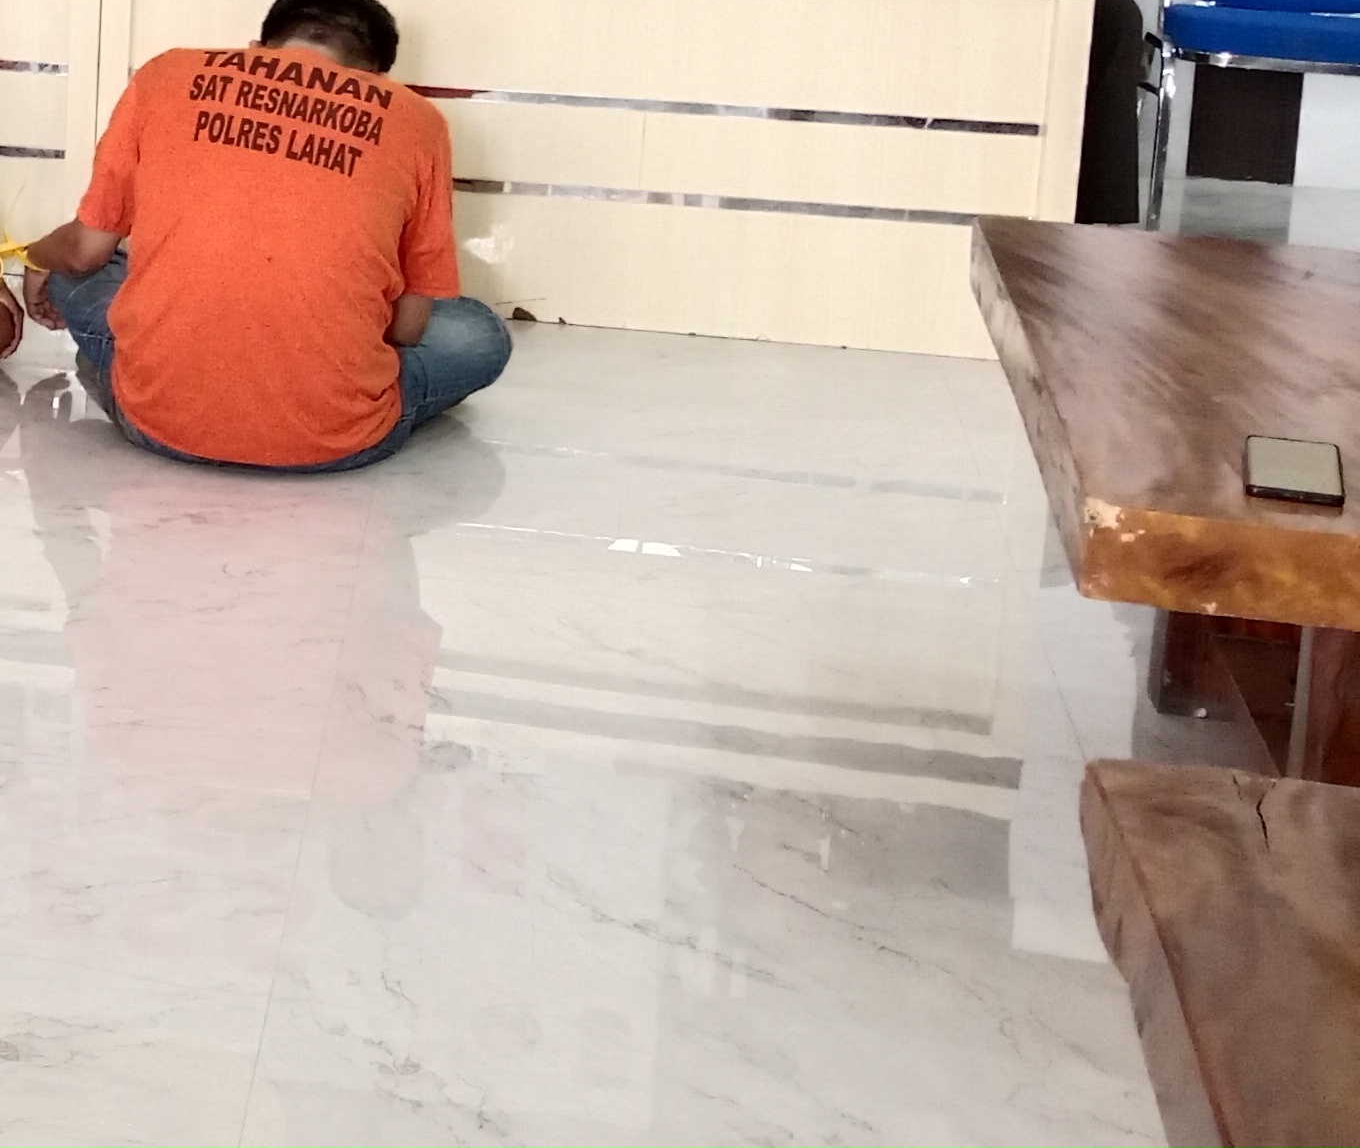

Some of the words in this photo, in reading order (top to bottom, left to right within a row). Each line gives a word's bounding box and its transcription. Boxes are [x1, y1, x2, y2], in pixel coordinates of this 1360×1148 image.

[189, 74, 233, 102] SAT
[235, 80, 384, 146] RESNARKOBA
[204, 51, 393, 109] TAHANAN
[193, 111, 282, 155] POLRES
[285, 130, 362, 177] LAHAT
